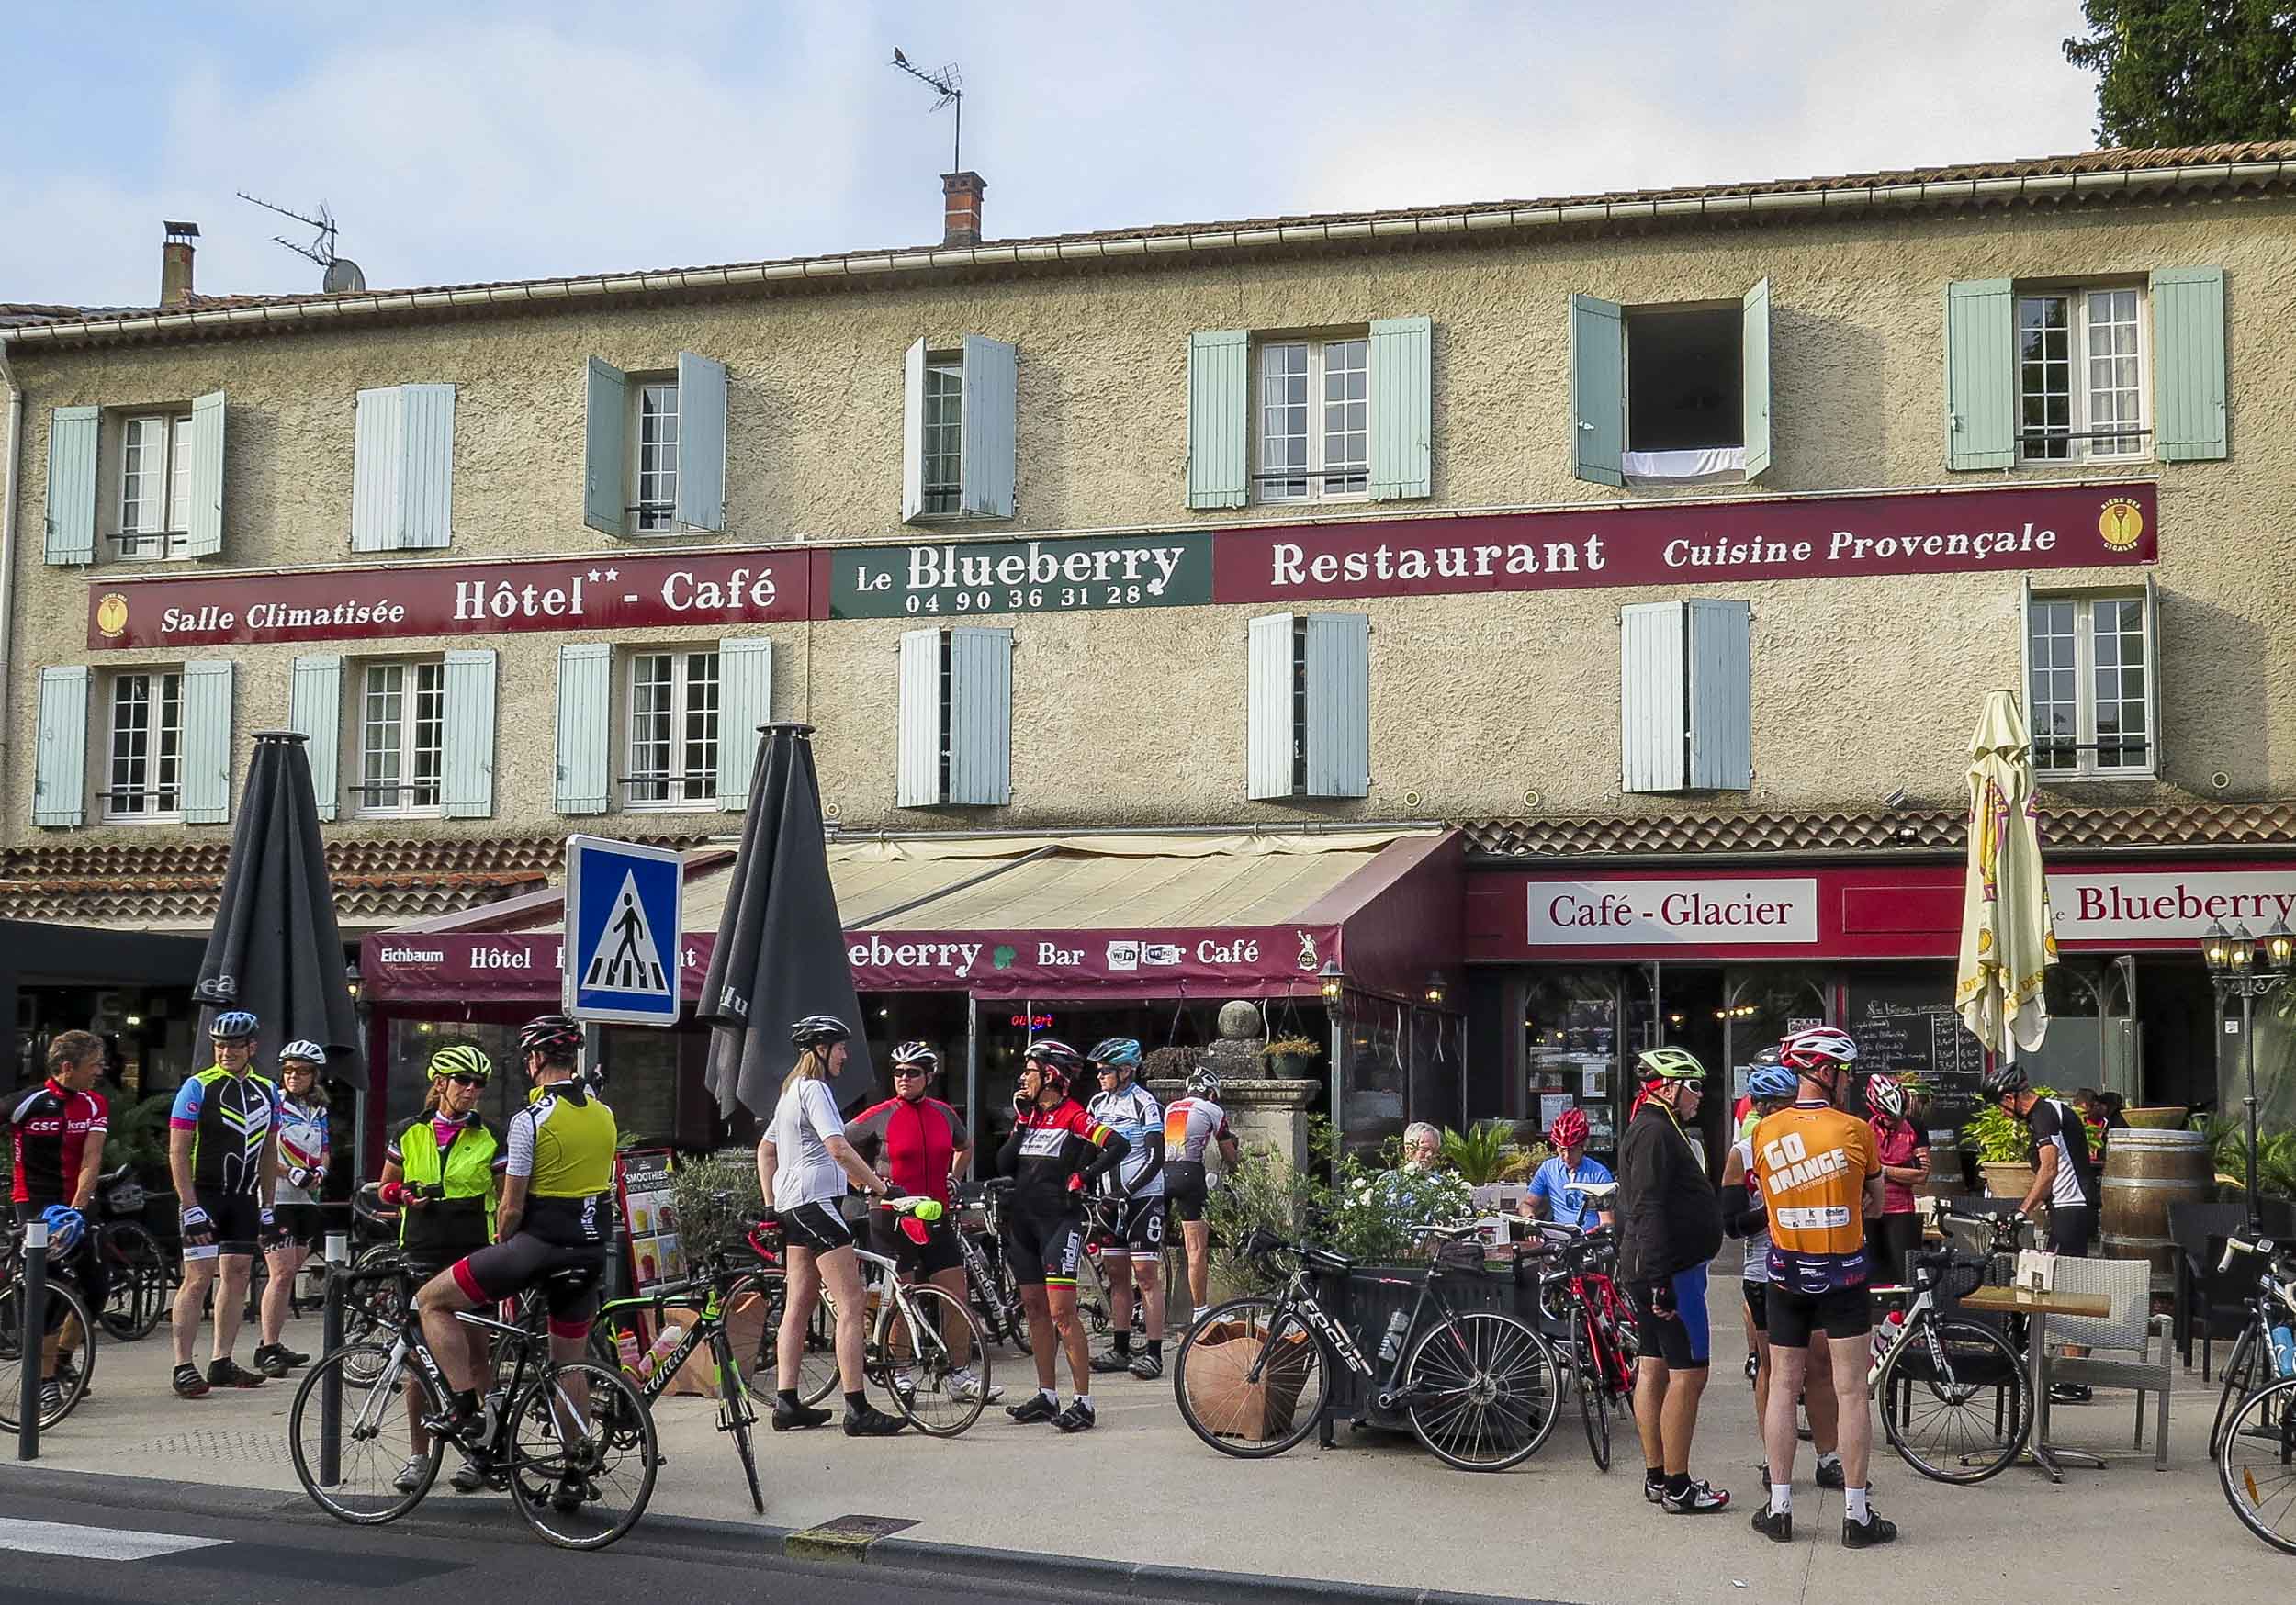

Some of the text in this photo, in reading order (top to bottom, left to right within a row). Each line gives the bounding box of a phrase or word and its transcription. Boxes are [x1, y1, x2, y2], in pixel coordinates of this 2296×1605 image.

[1269, 533, 1606, 586] Restaurant
[1663, 522, 2058, 568] Cuisine Provençale
[856, 542, 1185, 592] Le Blueberry
[454, 575, 585, 620] Hôtel
[660, 568, 777, 612] Café
[905, 584, 1141, 613] 04 90 36 31 28
[161, 599, 406, 633] Salle Climatisée
[1549, 893, 1633, 927] Café
[1660, 892, 1794, 926] Glacier
[2076, 884, 2296, 923] Blueberry
[380, 947, 445, 963] Eichbaum
[469, 946, 532, 970] Hôtel
[847, 935, 1085, 973] eberry Bar
[1196, 938, 1259, 964] Café
[30, 1121, 60, 1131] CSC
[1763, 1131, 1807, 1172] GO
[1304, 1297, 1362, 1373] FOCUS
